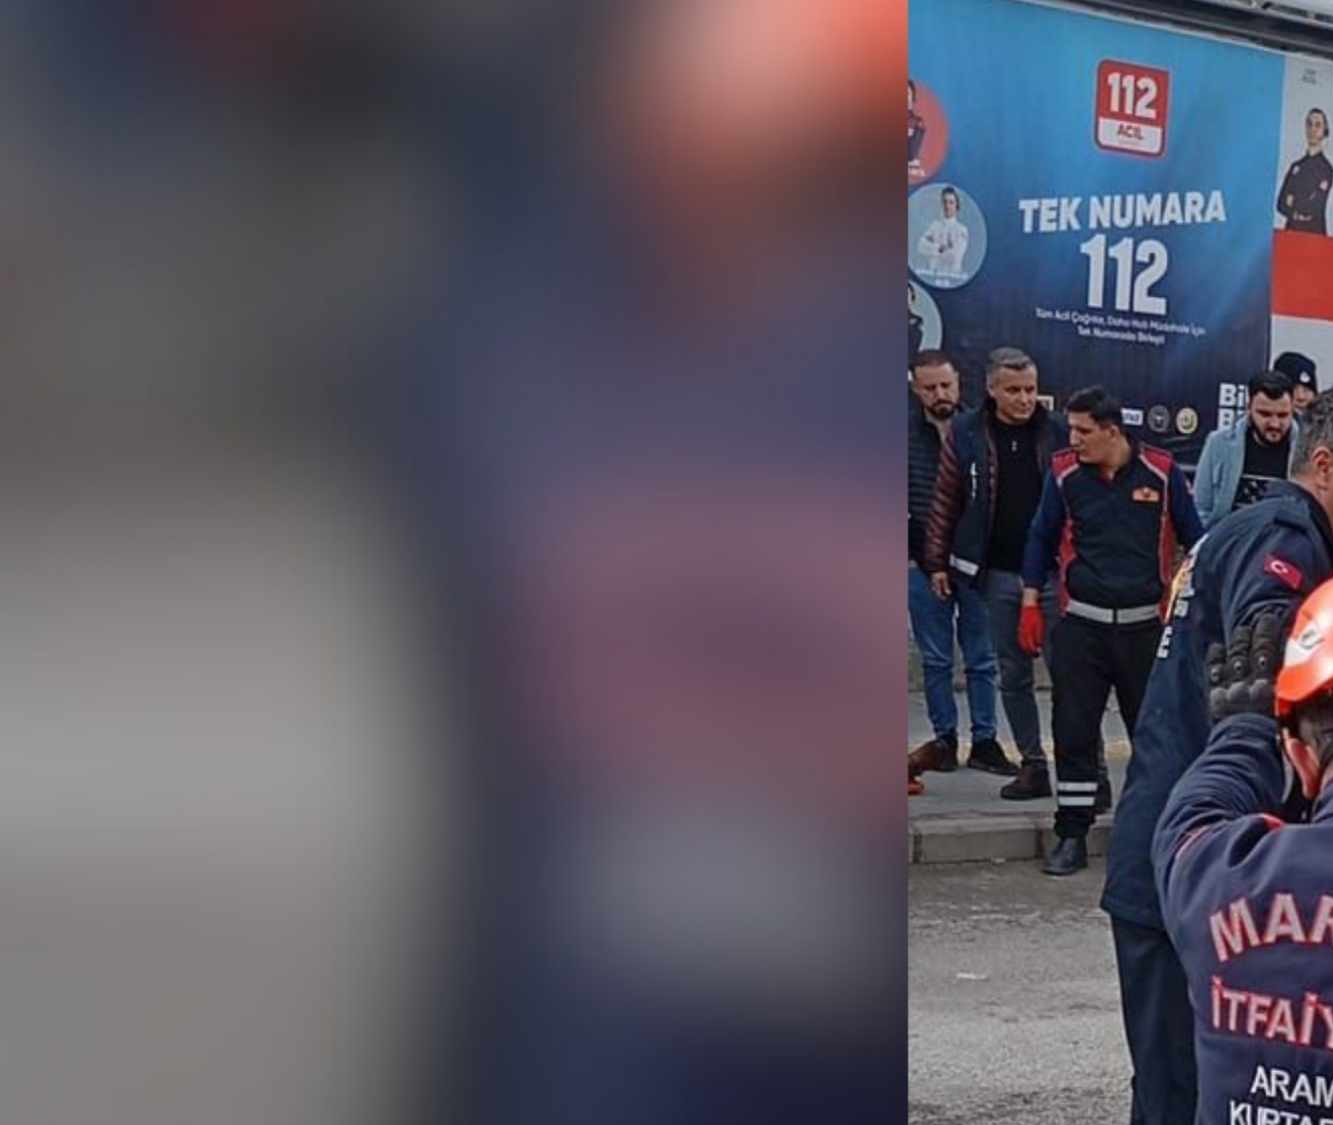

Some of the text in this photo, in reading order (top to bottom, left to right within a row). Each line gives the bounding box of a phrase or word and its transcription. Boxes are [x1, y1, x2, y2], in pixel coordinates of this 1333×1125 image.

[1108, 72, 1157, 119] 112
[1018, 190, 1226, 233] TEK NUMARA
[1079, 234, 1168, 315] 112
